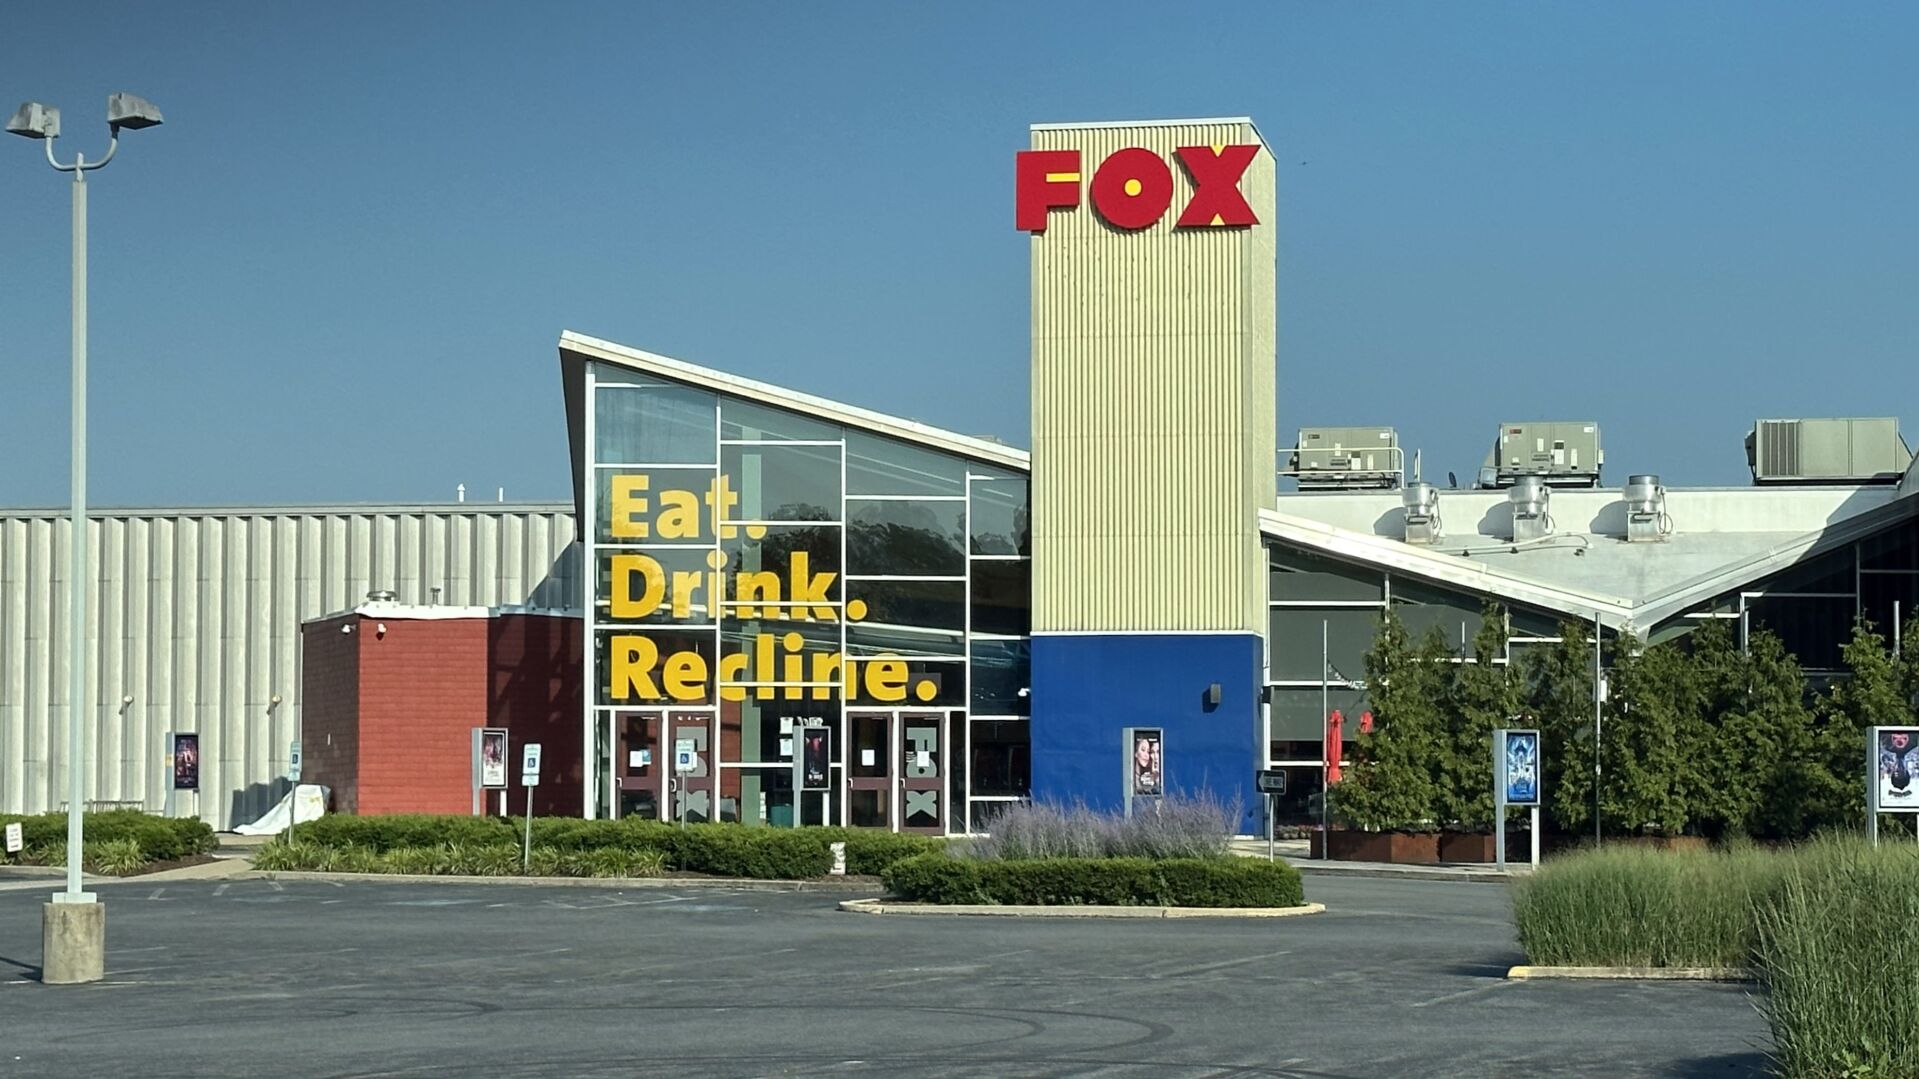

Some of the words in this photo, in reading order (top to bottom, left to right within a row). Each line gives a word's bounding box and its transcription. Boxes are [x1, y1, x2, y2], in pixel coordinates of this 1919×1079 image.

[1016, 144, 1262, 231] FOX
[610, 474, 768, 539] Eat.
[610, 550, 868, 621] Drink.
[610, 632, 938, 701] Recline.
